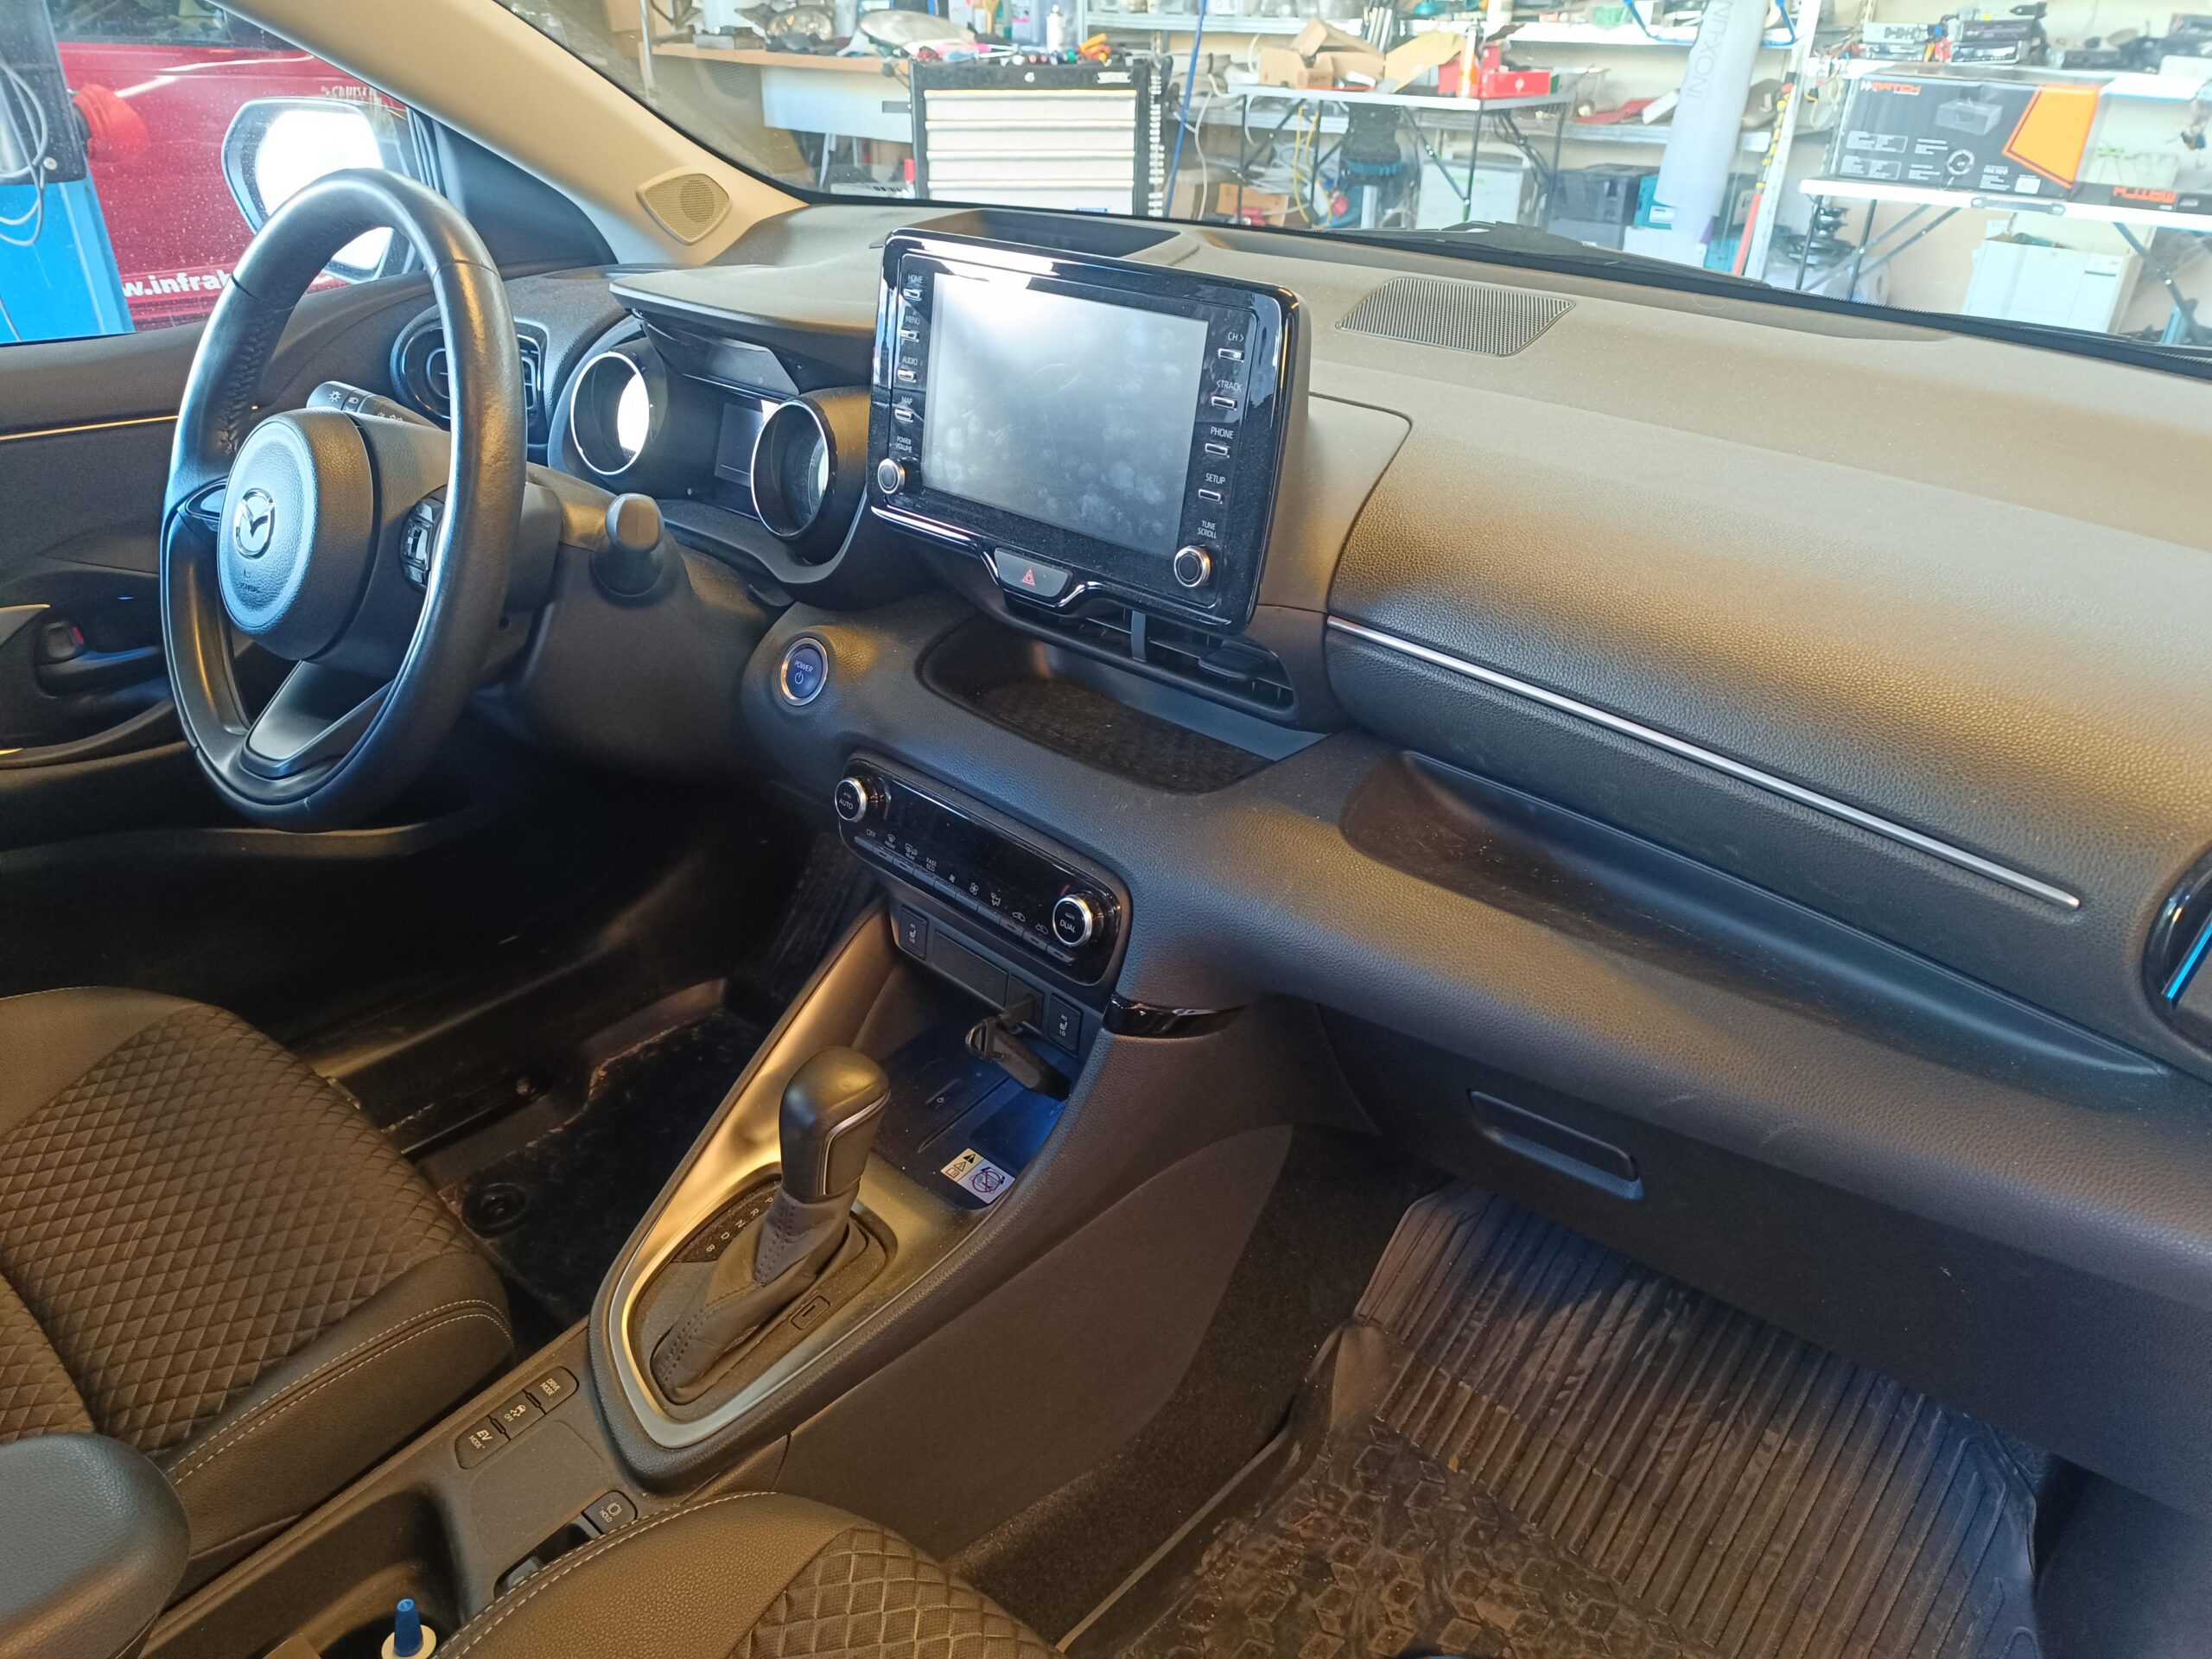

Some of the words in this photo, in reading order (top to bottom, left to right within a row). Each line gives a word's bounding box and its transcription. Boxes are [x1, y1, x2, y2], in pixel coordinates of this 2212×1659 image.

[907, 275, 923, 284] HOME
[905, 315, 920, 325] MENU
[902, 356, 918, 365] AUDIO
[901, 396, 913, 404] MAP
[1210, 426, 1234, 440] PHONE
[897, 435, 912, 445] POWER
[895, 442, 912, 453] VOLUME
[1205, 473, 1226, 485] SETUP
[1201, 520, 1217, 531] TUNE
[1197, 528, 1217, 539] SCROLL
[795, 660, 814, 673] POWER
[839, 798, 854, 810] AUTO
[866, 829, 876, 838] OFF
[1059, 918, 1076, 933] DUAL
[734, 1219, 747, 1229] N
[539, 1382, 555, 1397] MODE
[546, 1377, 561, 1392] DRIVE
[476, 1429, 493, 1441] EV
[599, 1509, 613, 1522] HOLD
